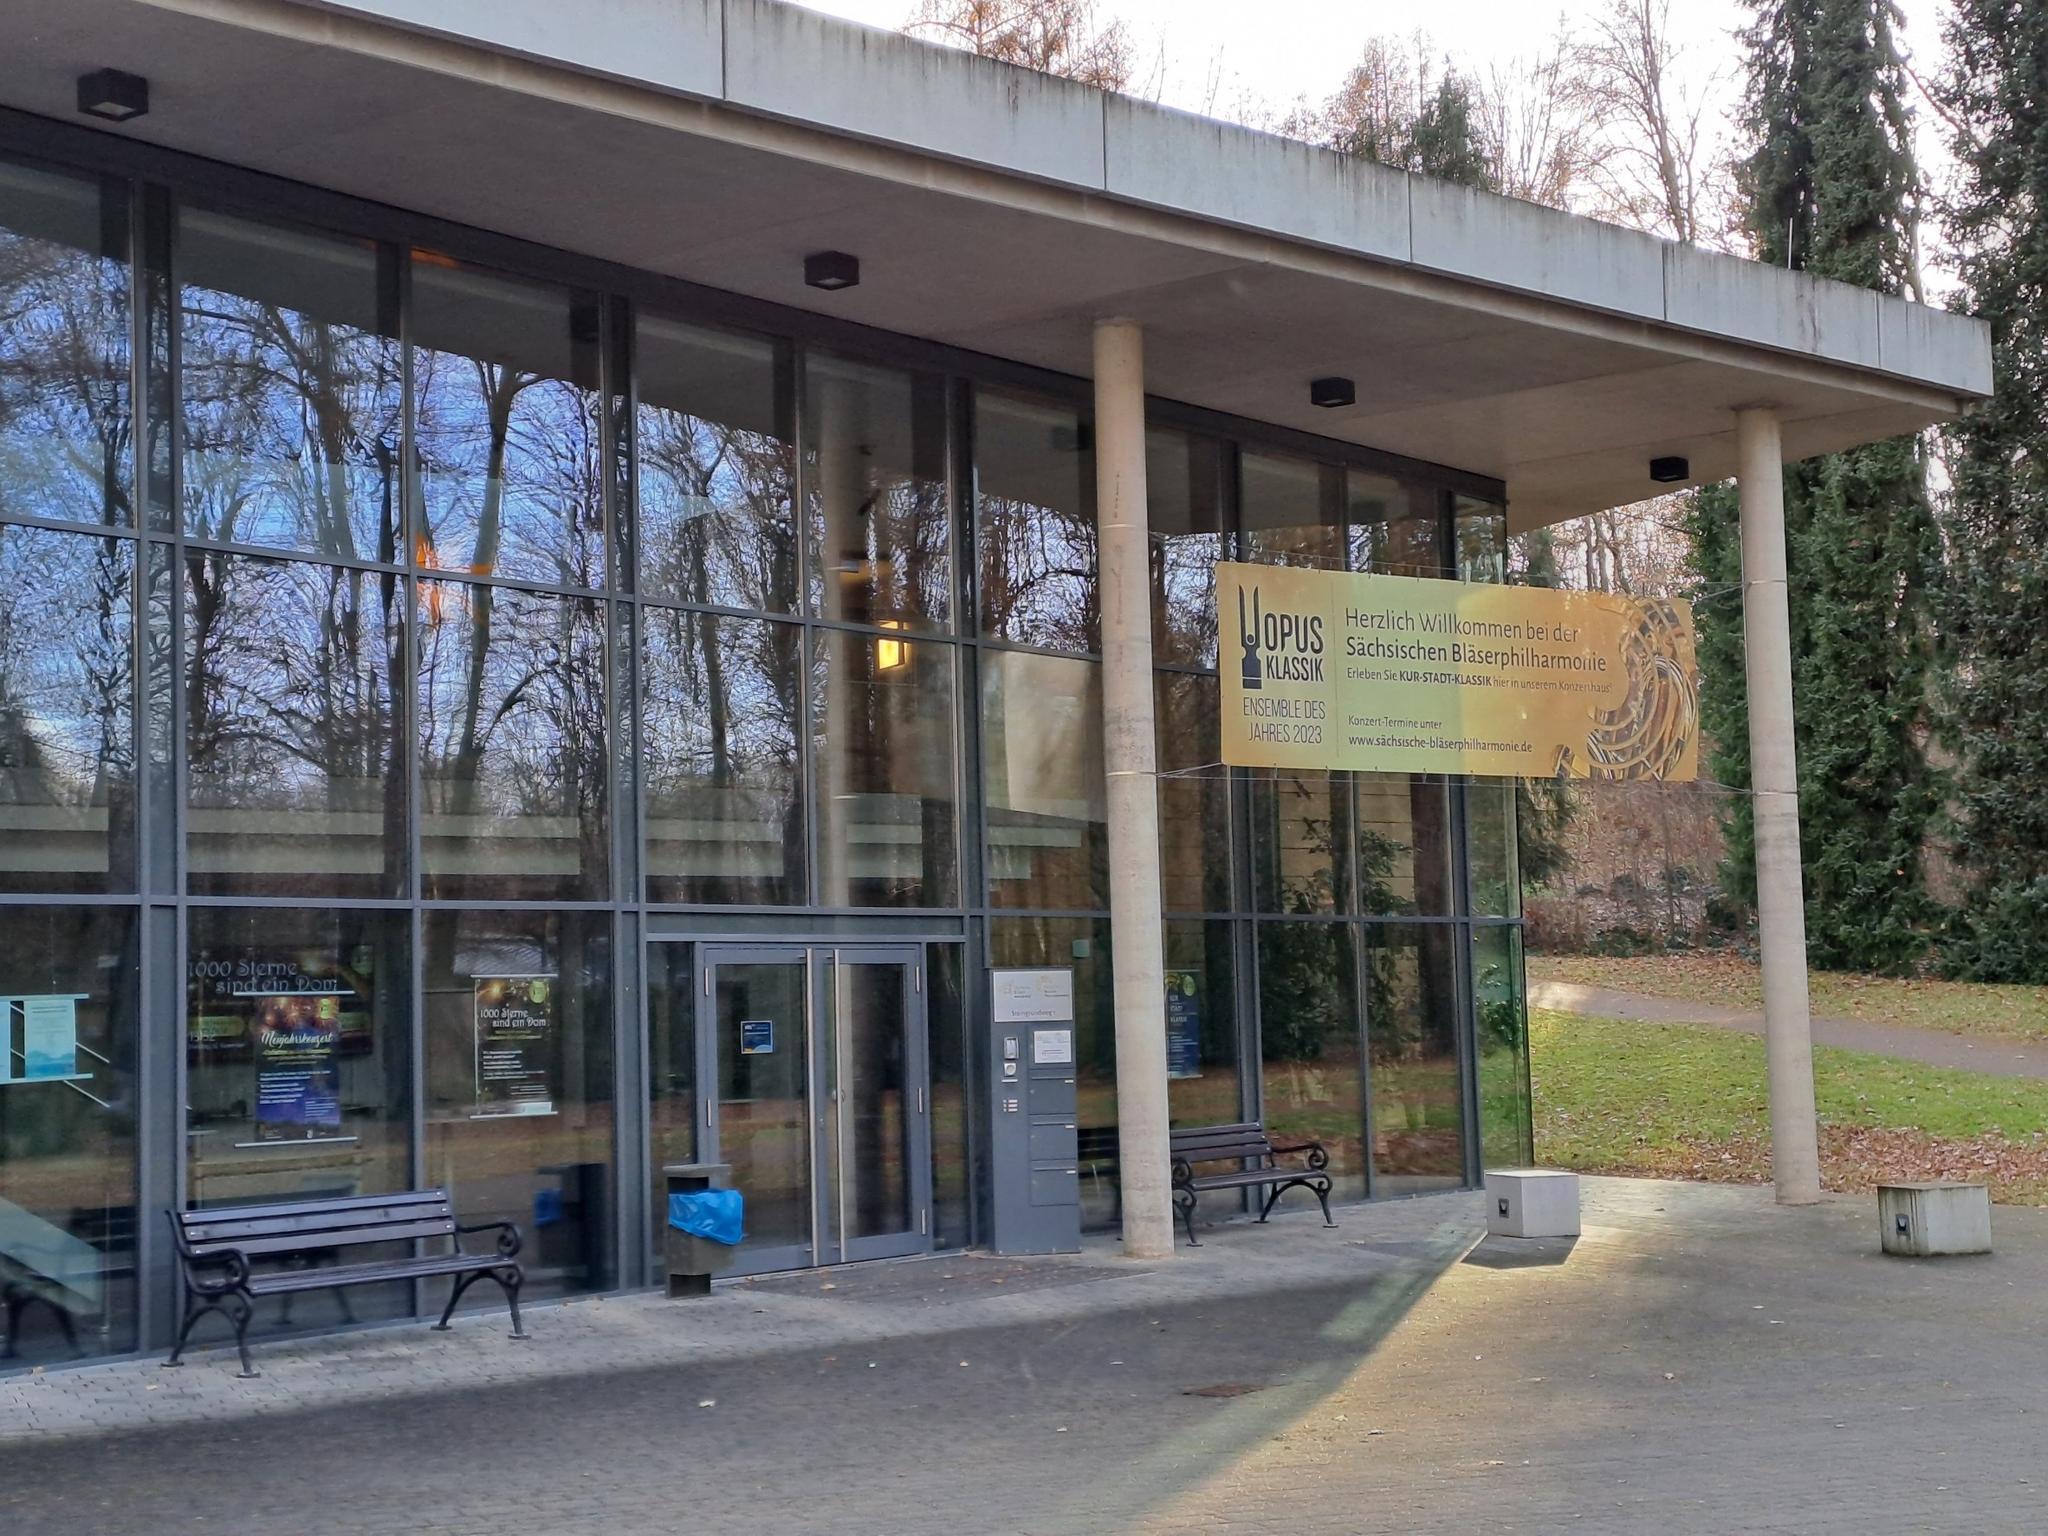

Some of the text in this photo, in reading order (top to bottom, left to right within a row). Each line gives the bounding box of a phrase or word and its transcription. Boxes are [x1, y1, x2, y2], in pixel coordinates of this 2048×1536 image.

[1264, 612, 1324, 654] OPUS
[1346, 607, 1579, 642] Herzlich Willkommen bei der
[1346, 636, 1607, 672] Sächsischen Bläserphilharmonie
[1266, 655, 1324, 682] KLASSIK
[1347, 667, 1382, 680] Erleben
[1384, 669, 1398, 681] Sie
[1399, 670, 1493, 687] KUR-STADT-KLASSIK
[1493, 676, 1509, 688] hier
[1510, 679, 1519, 689] in
[1520, 680, 1558, 691] unserem
[1243, 697, 1326, 720] ENSEMBLE DES
[1248, 723, 1322, 744] JAHRES 2023
[1348, 715, 1442, 730] Konzert-Termine unter
[1348, 734, 1533, 753] www.sächsische-bläserphilharmonie.de
[188, 961, 231, 977] 1000
[262, 977, 289, 992] ein
[480, 1008, 499, 1018] 1000
